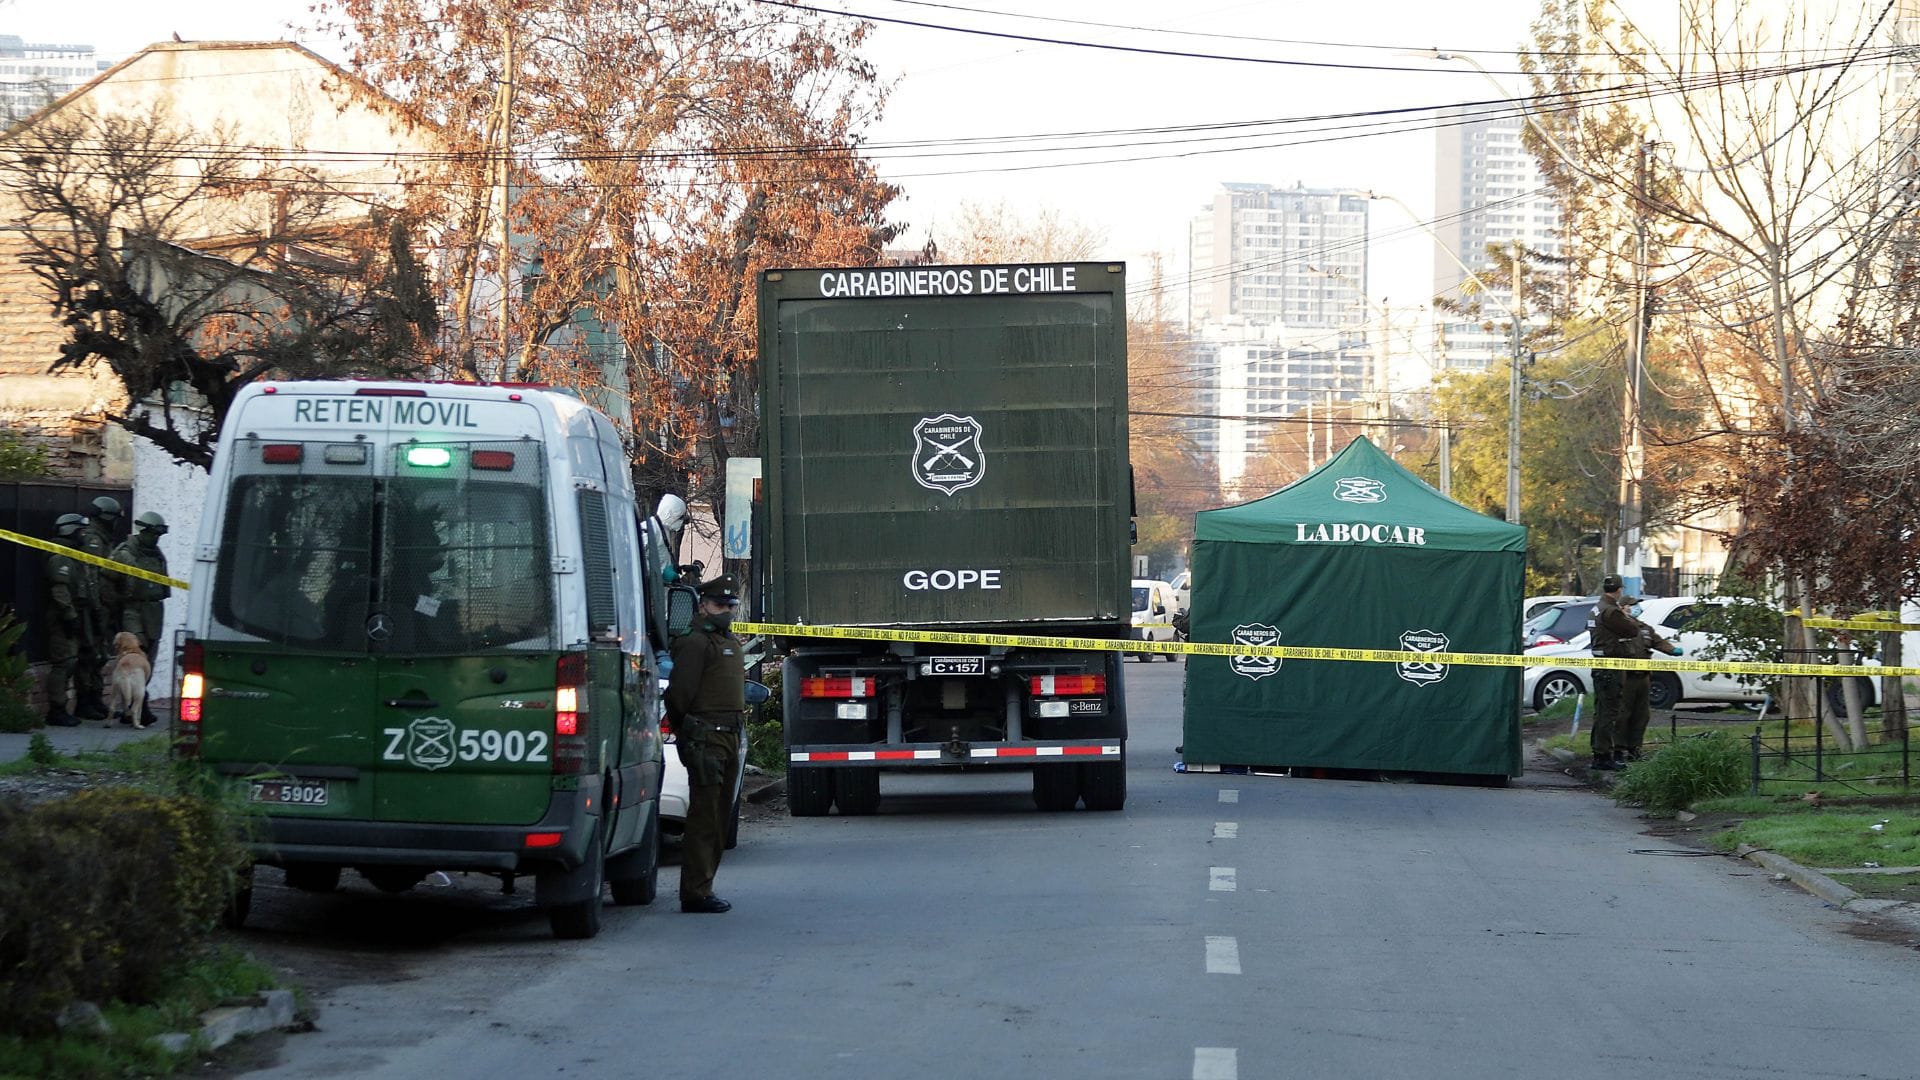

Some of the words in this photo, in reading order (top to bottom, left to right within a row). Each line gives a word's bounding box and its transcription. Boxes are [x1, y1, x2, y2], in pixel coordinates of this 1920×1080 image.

[820, 270, 973, 298] CARABINEROS
[980, 269, 1008, 294] DE
[1014, 267, 1076, 292] CHILE
[296, 399, 383, 423] RETEN
[394, 401, 477, 427] MOVIL
[1296, 523, 1426, 545] LABOCAR
[904, 570, 1001, 590] GOPE
[734, 624, 748, 632] PASAR
[758, 624, 786, 634] CARABINEROS
[795, 626, 806, 634] CHILE
[820, 627, 833, 636] PASAR
[844, 628, 872, 637] CARABINEROS
[874, 629, 880, 638] DE
[881, 629, 892, 638] CHILE
[930, 633, 959, 641] CARABINEROS
[968, 634, 979, 643] CHILE
[993, 635, 1007, 644] PASAR
[1017, 637, 1046, 646] CARABINEROS
[1049, 638, 1055, 646] DE
[1056, 638, 1067, 647] CHILE
[1105, 641, 1135, 650] CARABINEROS
[1143, 642, 1155, 650] CHILE
[1194, 644, 1224, 653] CARABINEROS
[1233, 646, 1244, 654] CHILE
[1251, 647, 1256, 655] NO
[1258, 647, 1273, 655] PASAR
[1283, 648, 1313, 657] CARABINEROS
[1315, 649, 1320, 657] DE
[1322, 649, 1334, 658] CHILE
[1340, 650, 1346, 658] NO
[1347, 650, 1363, 659] PASAR
[1373, 652, 1403, 660] CARABINEROS
[1407, 653, 1412, 661] DE
[1414, 653, 1424, 661] CHILE
[1431, 653, 1436, 662] NO
[1438, 654, 1453, 662] PASAR
[1464, 655, 1494, 664] CARABINEROS
[1496, 656, 1502, 664] DE
[935, 664, 946, 672] C
[956, 664, 979, 672] 157
[1071, 702, 1101, 710] s-Benz
[383, 728, 405, 760] Z
[459, 730, 548, 762] 5902
[281, 786, 325, 802] 5902
